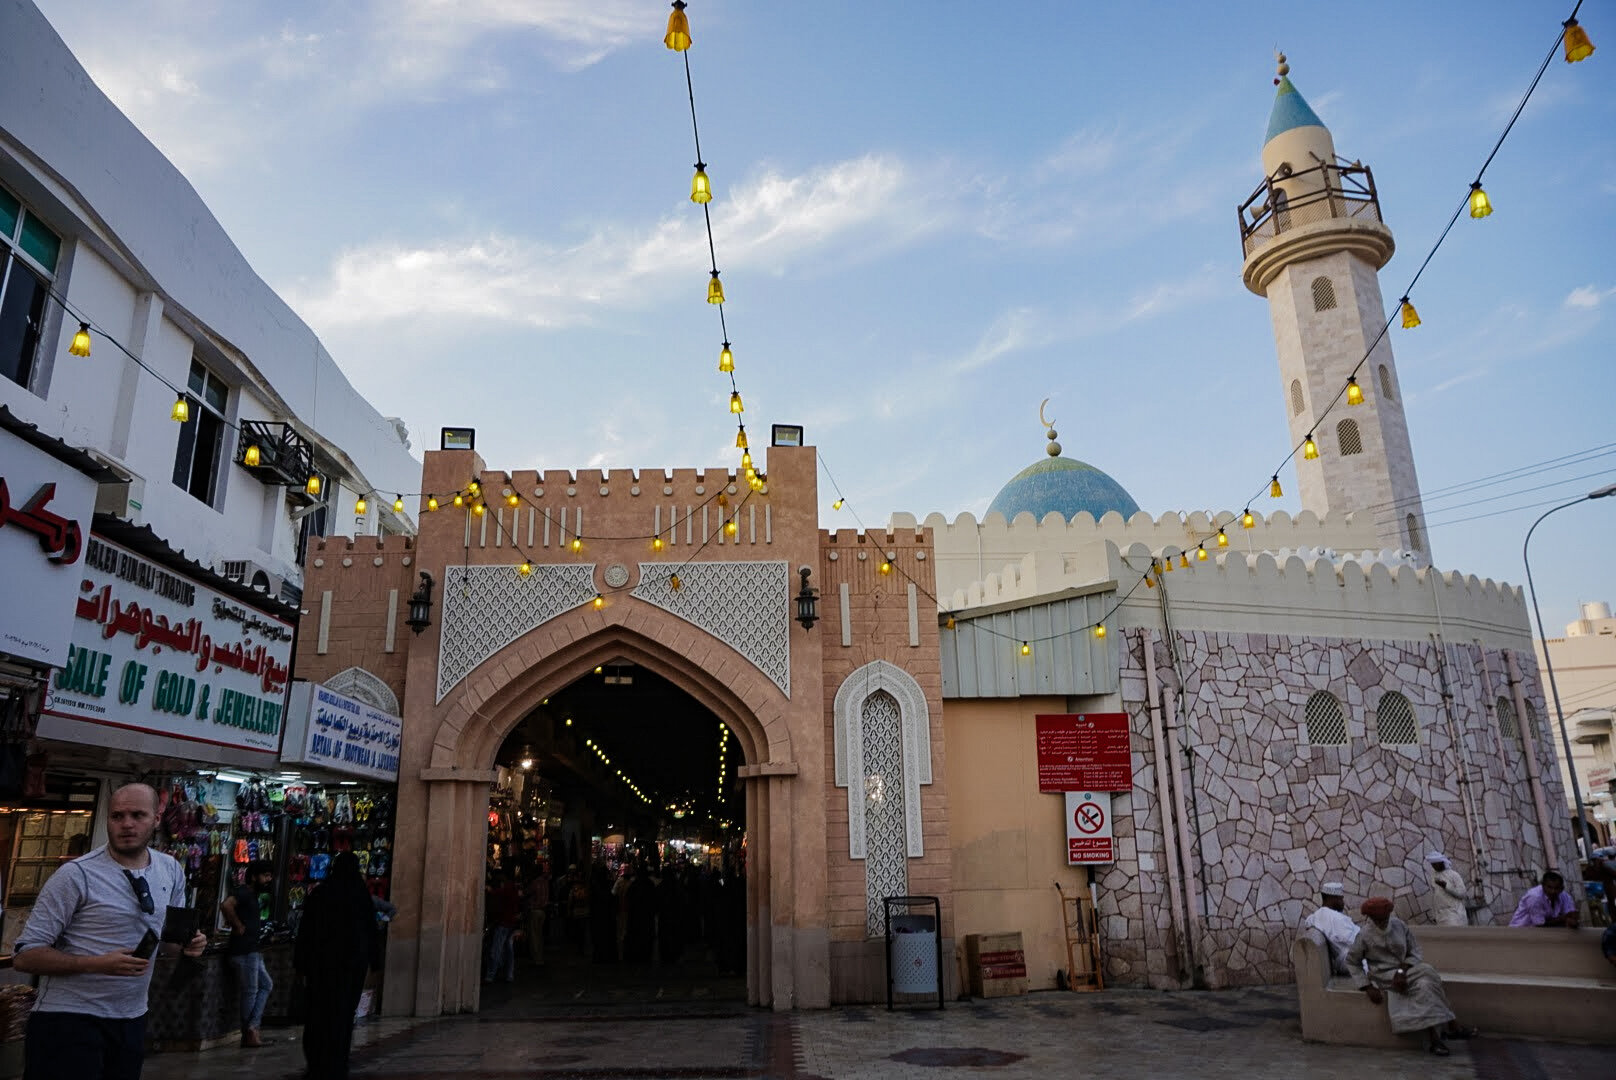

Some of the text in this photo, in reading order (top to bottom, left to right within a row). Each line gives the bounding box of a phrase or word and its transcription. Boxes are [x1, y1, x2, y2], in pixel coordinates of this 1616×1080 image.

[116, 553, 138, 582] BIN
[135, 562, 155, 590] ALI
[155, 571, 195, 607] TRADING
[210, 638, 266, 676] الذهب
[261, 656, 288, 694] بيع
[54, 643, 112, 698] SALE
[119, 660, 148, 705] OF
[152, 669, 196, 716] GOLD
[195, 684, 210, 720] &
[213, 688, 283, 737] JEWELLERY
[1082, 851, 1110, 859] SMOKING
[1092, 839, 1109, 848] ممنوع
